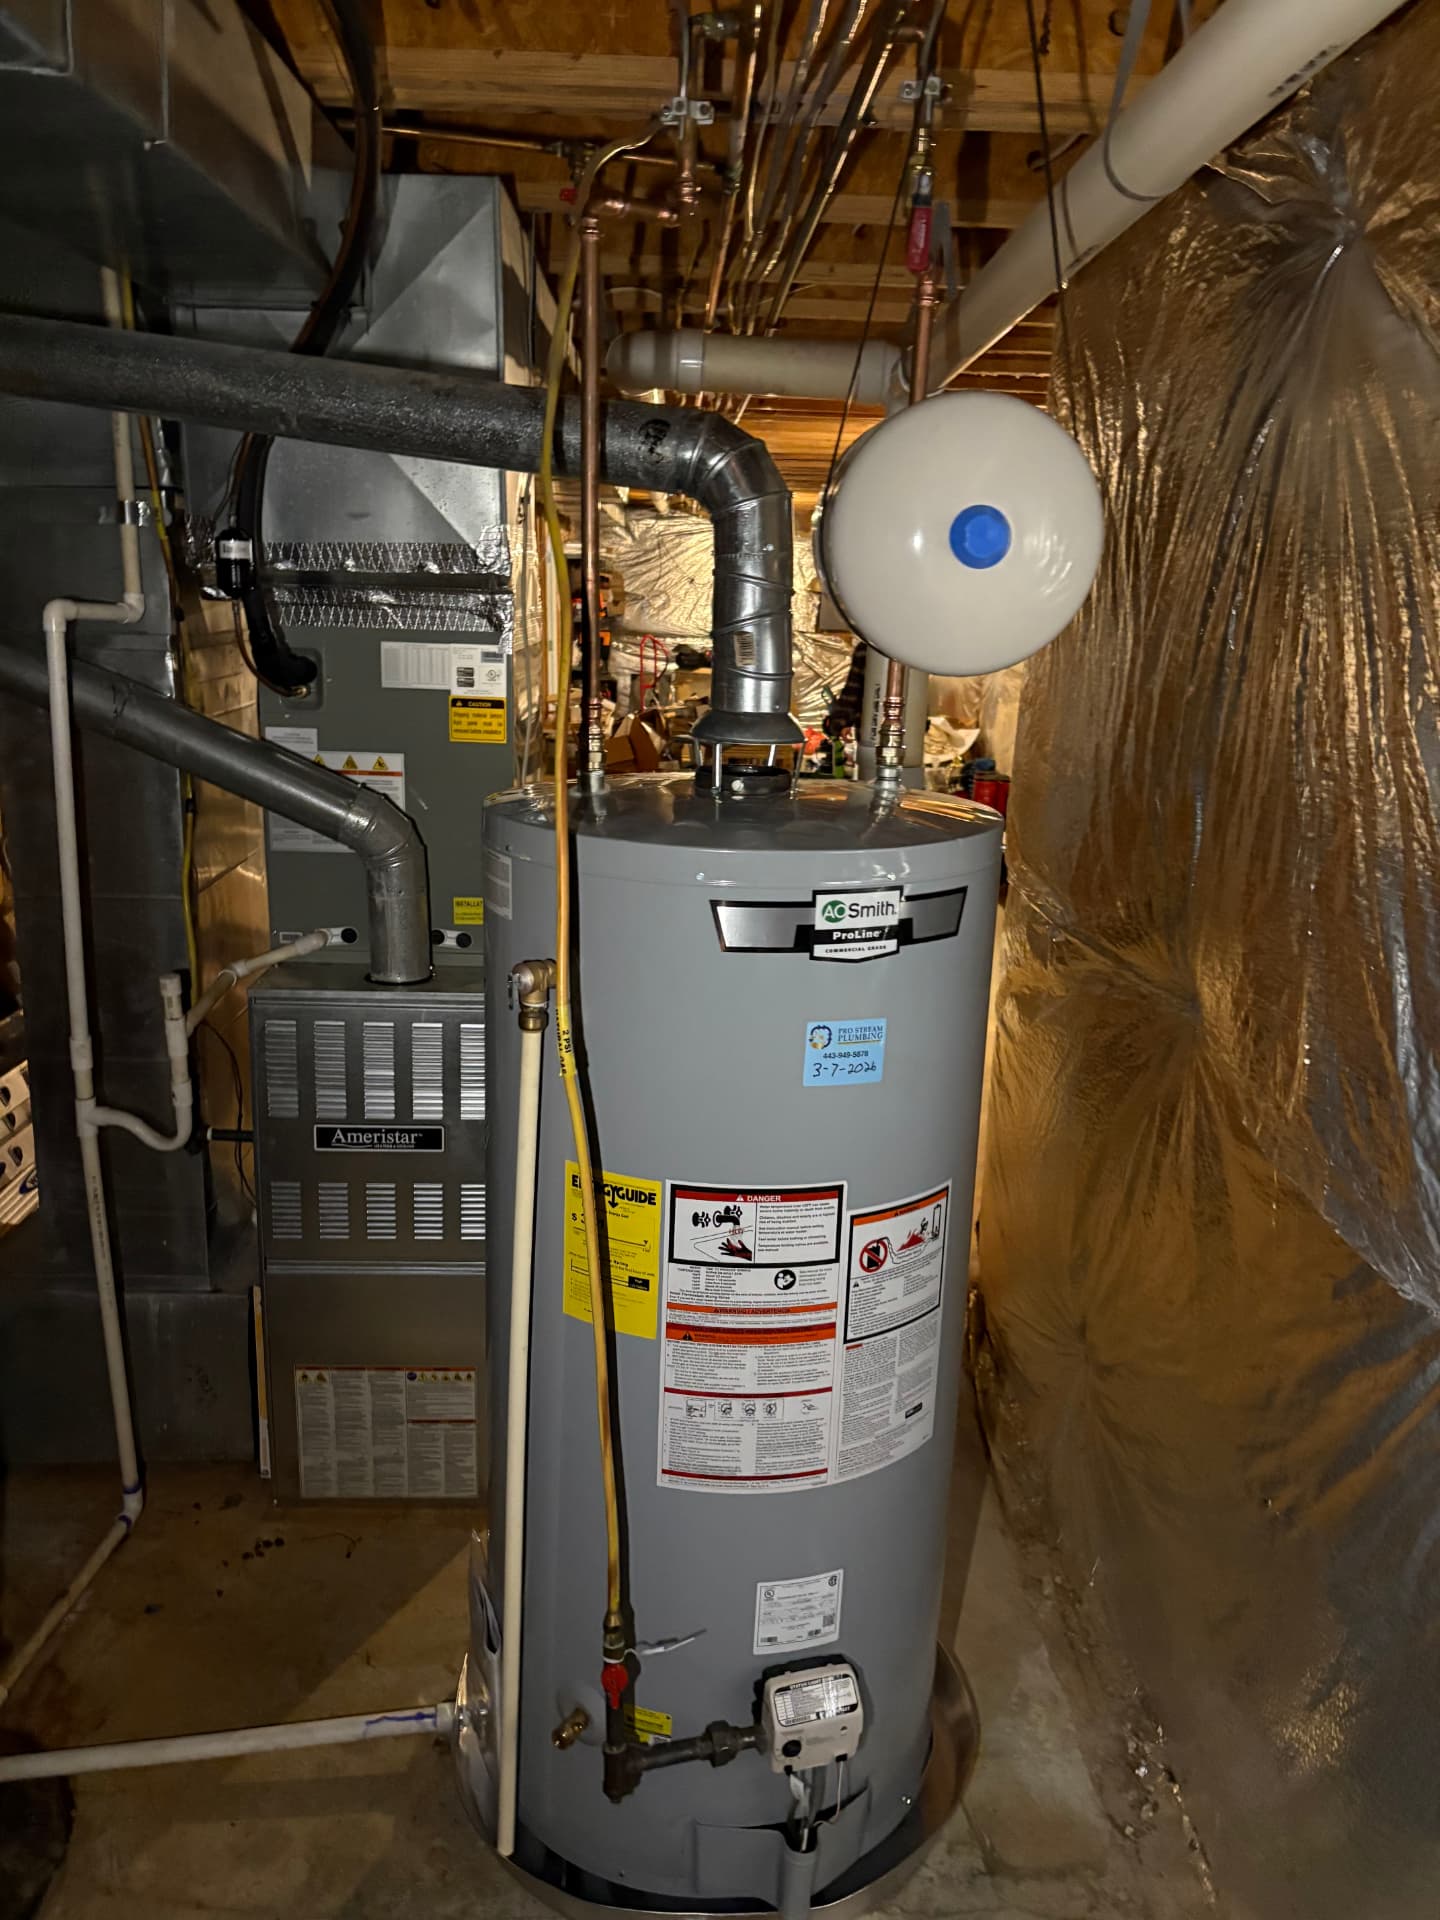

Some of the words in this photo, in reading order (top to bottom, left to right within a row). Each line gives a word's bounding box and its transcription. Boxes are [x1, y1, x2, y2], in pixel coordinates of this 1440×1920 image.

[848, 900, 895, 918] Smith
[832, 929, 880, 940] ProLine
[837, 1032, 883, 1042] PLUMBING
[855, 1025, 883, 1033] STREAM
[563, 1037, 572, 1053] PSI
[812, 1060, 877, 1078] 3-7-2026
[331, 1127, 417, 1144] Ameristar
[571, 1174, 657, 1206] EGYGUIDE
[746, 1194, 782, 1202] DANGER
